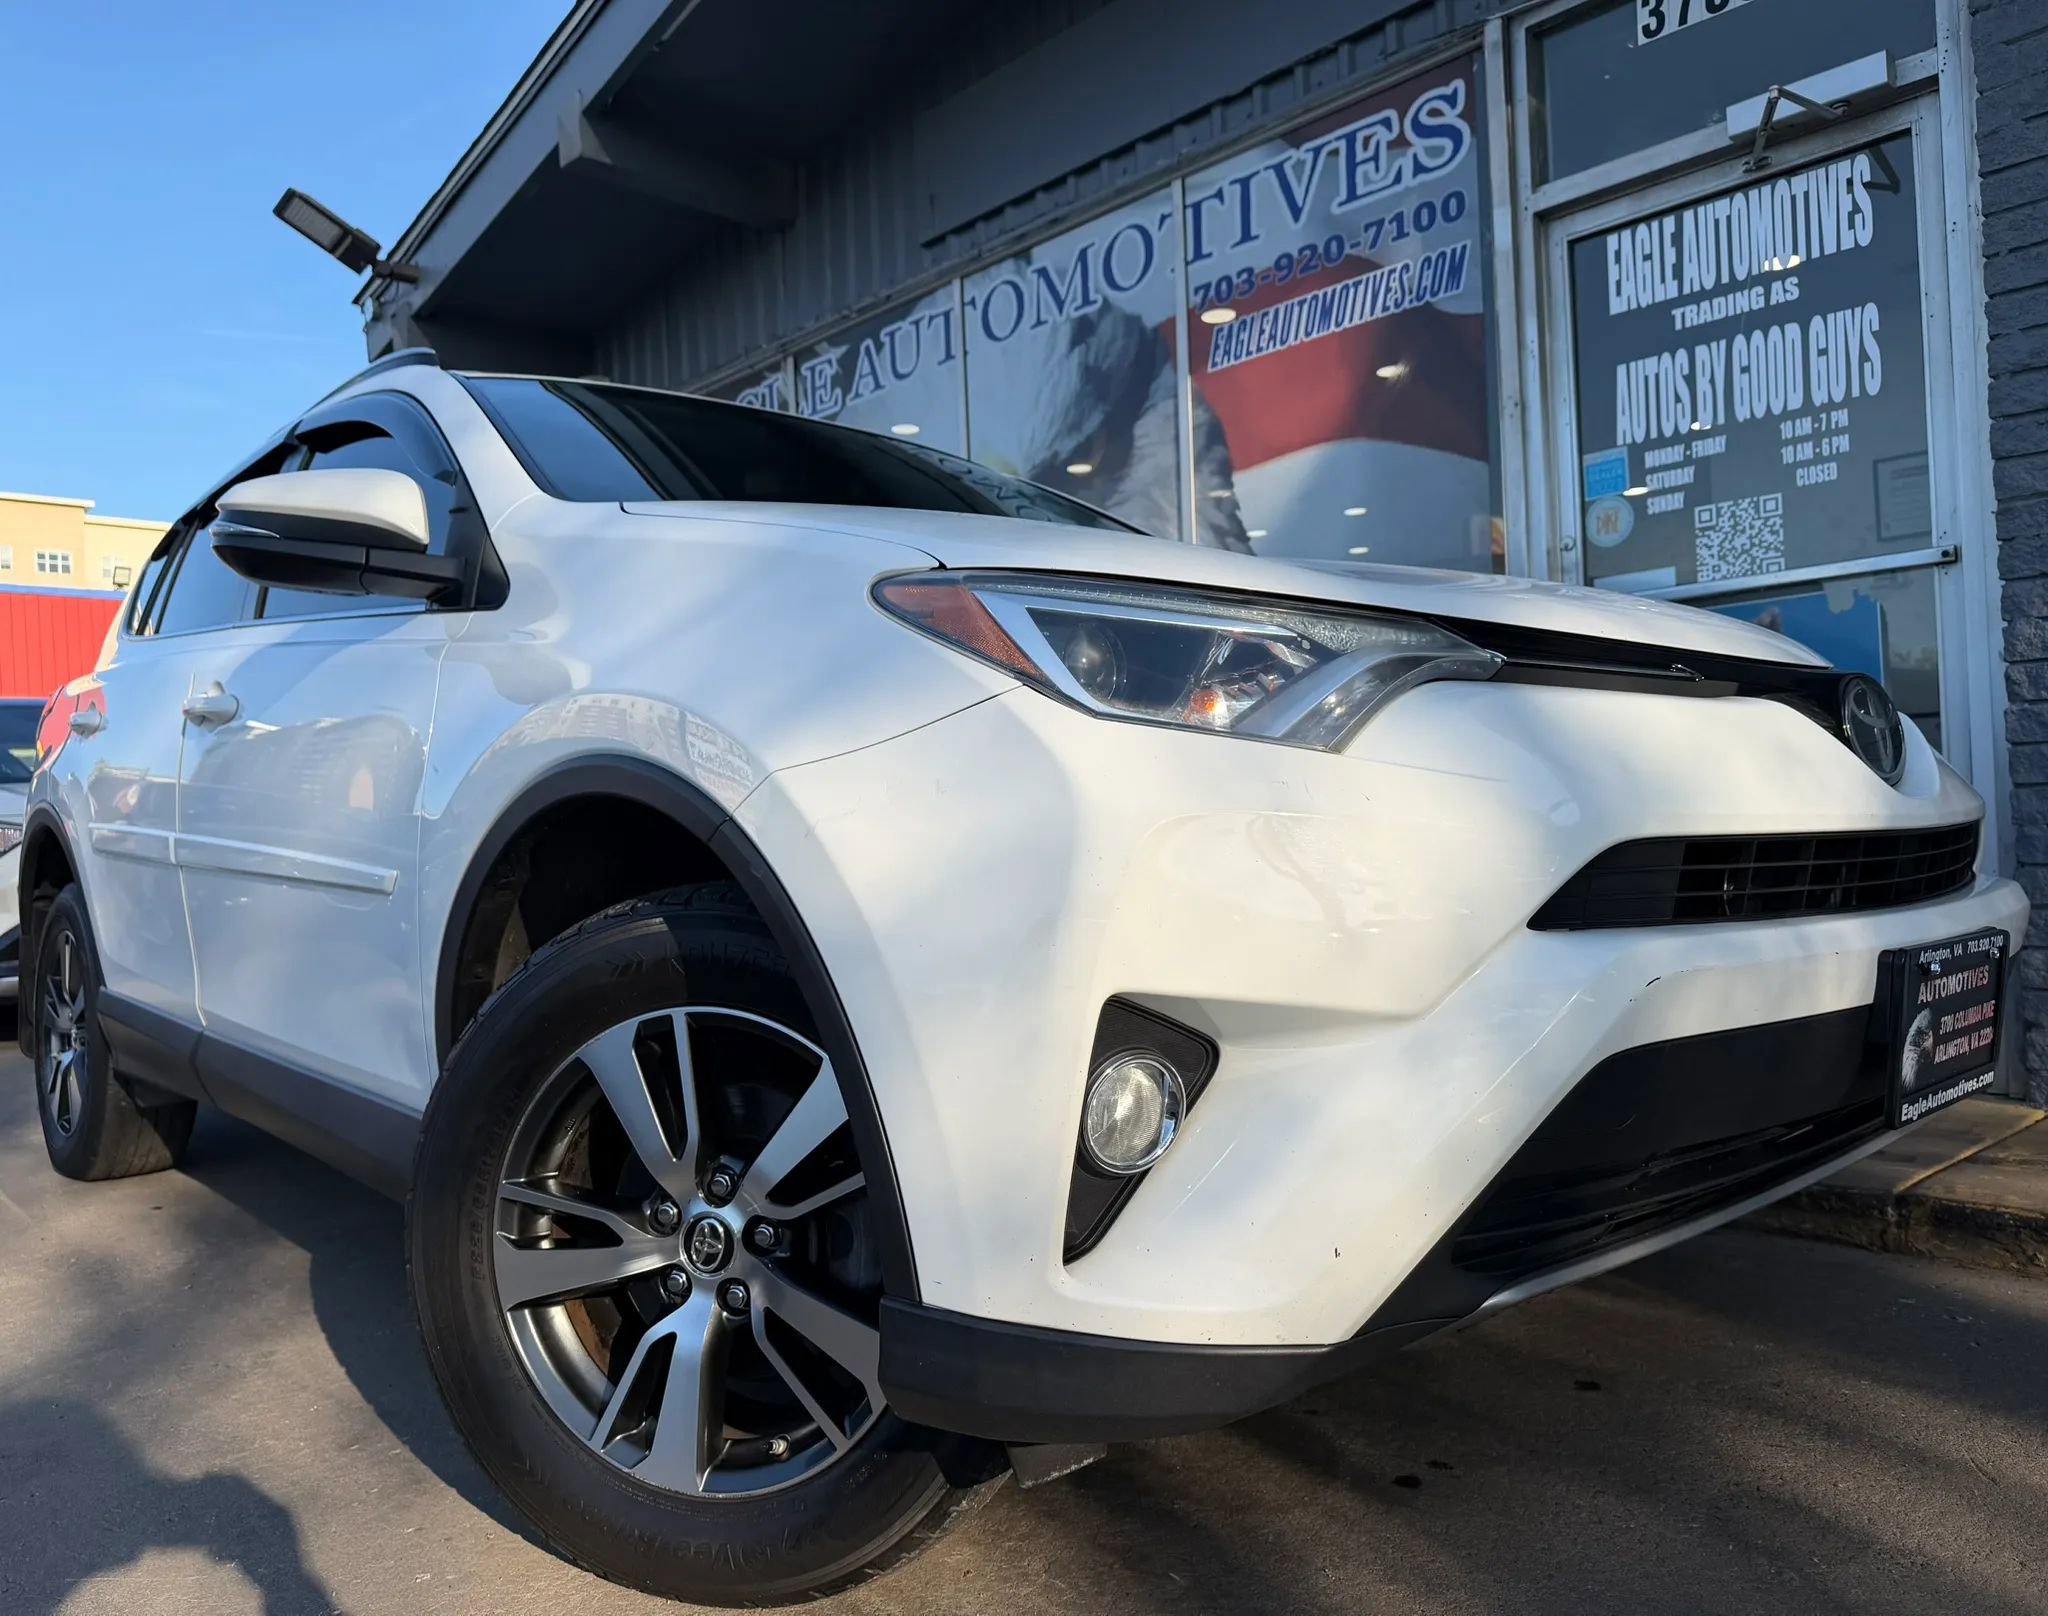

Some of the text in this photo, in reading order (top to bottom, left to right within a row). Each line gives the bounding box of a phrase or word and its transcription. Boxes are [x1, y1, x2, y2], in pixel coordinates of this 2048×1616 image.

[1193, 189, 1467, 312] 703-920-7100
[1606, 153, 1874, 316] EAGLE AUTOMOTIVES
[1207, 239, 1471, 373] EAGLEAUTOMOTIVES.COM
[1671, 276, 1799, 331] TRADING AS
[1616, 302, 1882, 446] AUTOS BY GOOD GUYS
[1780, 420, 1793, 440] 10
[1794, 416, 1812, 437] AM
[1820, 413, 1827, 431] 7
[1830, 408, 1849, 429] PM
[1644, 444, 1685, 469] MONDAY
[1692, 435, 1727, 459] FRIDAY
[1781, 445, 1795, 464] 10
[1796, 440, 1814, 462] AM
[1821, 438, 1830, 456] 6
[1832, 434, 1850, 454] PM
[1645, 466, 1696, 491] SATURDAY
[1796, 462, 1838, 487] CLOSED
[1646, 491, 1685, 515] SUNDAY
[1919, 947, 1952, 964] Arlington,
[1953, 943, 1963, 956] VA
[1917, 965, 1989, 1004] AUTOMOTIVES
[1901, 1071, 1994, 1122] EagleAutomotives.com
